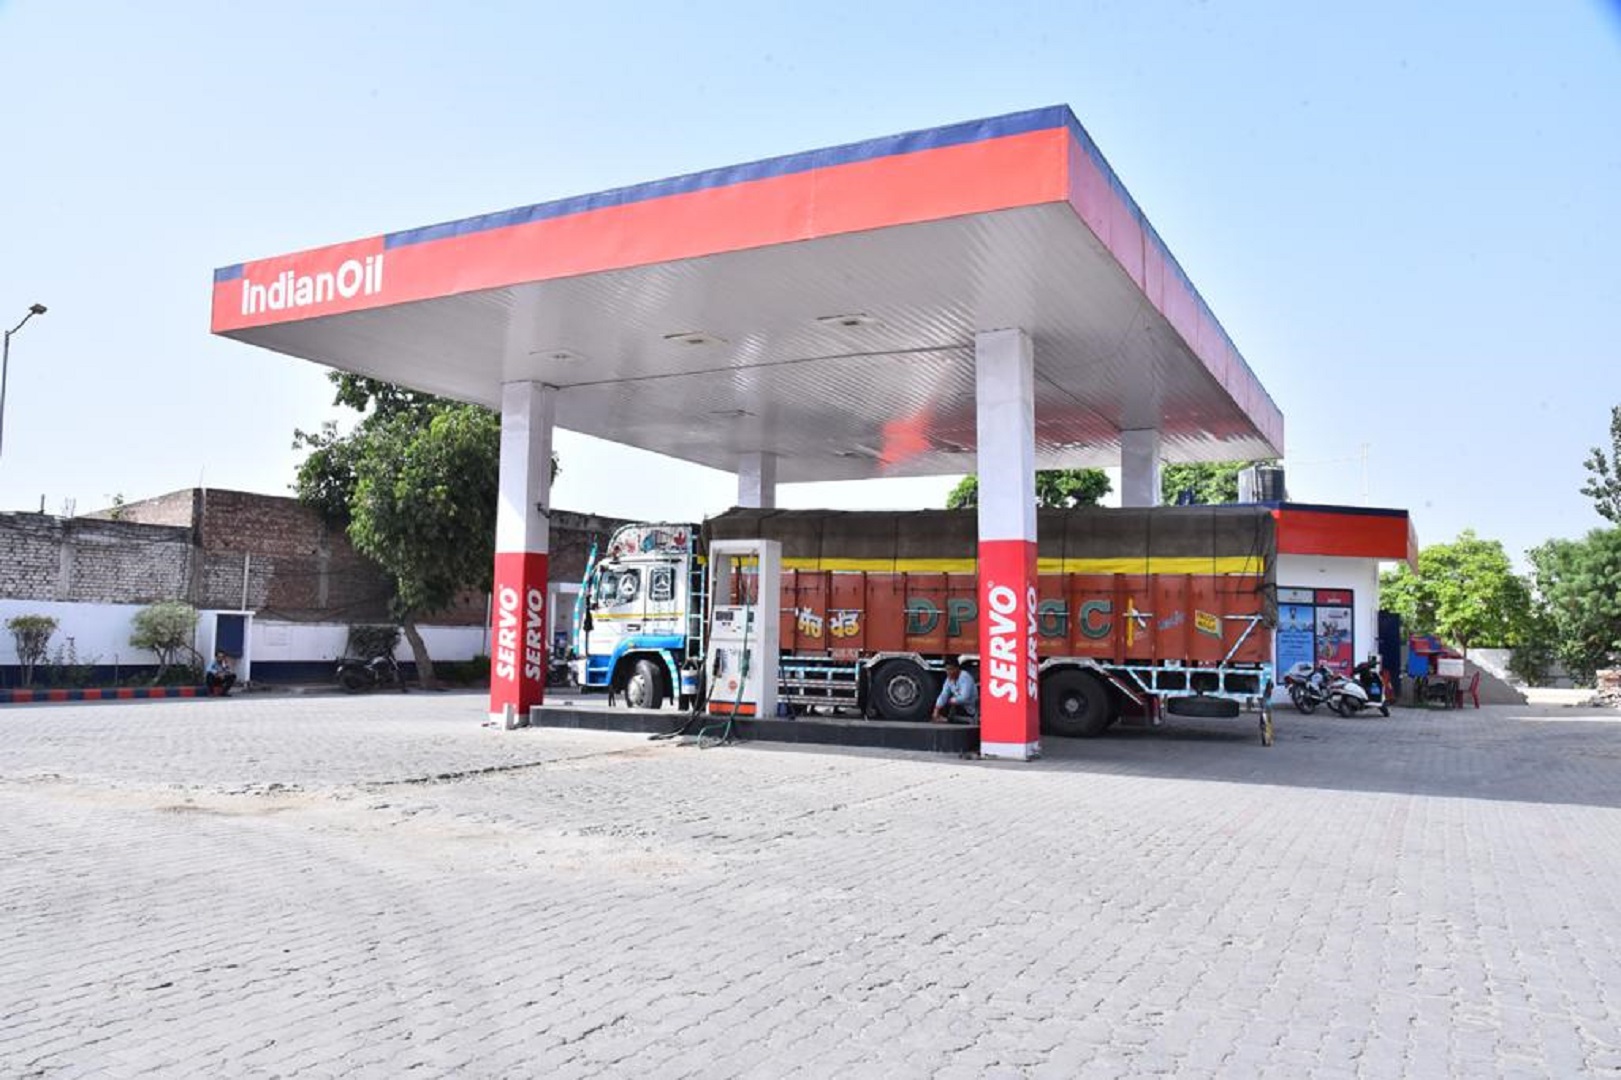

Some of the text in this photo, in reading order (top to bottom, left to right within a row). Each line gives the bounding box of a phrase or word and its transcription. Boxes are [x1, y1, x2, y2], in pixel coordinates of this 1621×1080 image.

[241, 254, 384, 315] IndianOil
[497, 587, 518, 681] SERVO
[525, 588, 544, 682] SERVO
[989, 585, 1018, 703] SERVO
[1026, 586, 1038, 701] SERVO
